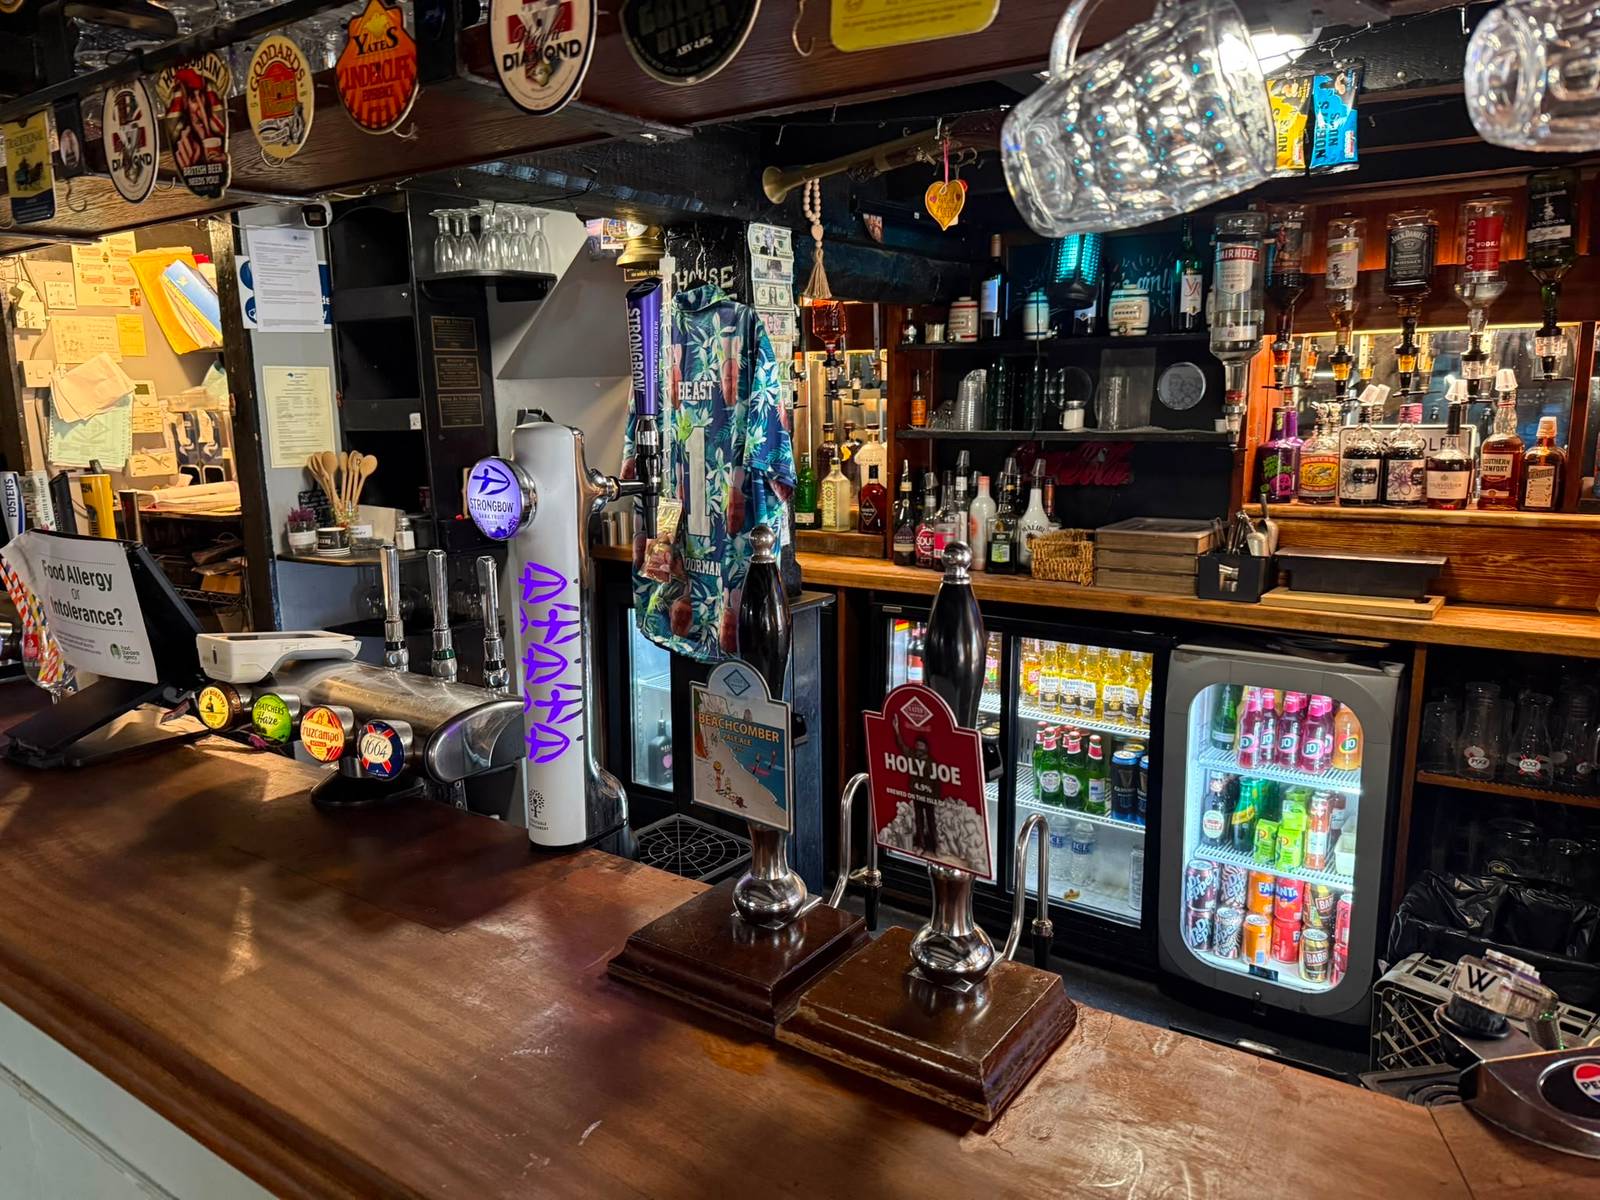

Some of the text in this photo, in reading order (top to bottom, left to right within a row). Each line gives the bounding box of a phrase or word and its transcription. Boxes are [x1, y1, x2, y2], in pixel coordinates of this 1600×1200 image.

[352, 26, 400, 56] YATES
[250, 43, 306, 92] GODDARDS
[675, 264, 734, 291] HOUSE
[629, 308, 645, 393] STRONGBOW
[677, 380, 714, 401] BEAST
[685, 426, 711, 537] 1
[5, 478, 18, 518] FOSTERS
[469, 498, 515, 513] STRONGBOW
[916, 535, 932, 546] SOU
[41, 559, 113, 592] Food Allergy
[71, 588, 80, 600] or
[50, 595, 124, 626] Intolerance?
[256, 711, 279, 725] Haze
[698, 712, 780, 744] BEACHCOMBER
[363, 739, 388, 758] 1664
[884, 752, 962, 786] HOLY JOE
[886, 787, 906, 797] BREWED
[907, 792, 916, 800] ON
[916, 794, 926, 802] THE
[1050, 836, 1063, 845] CE
[1072, 842, 1089, 851] ICE
